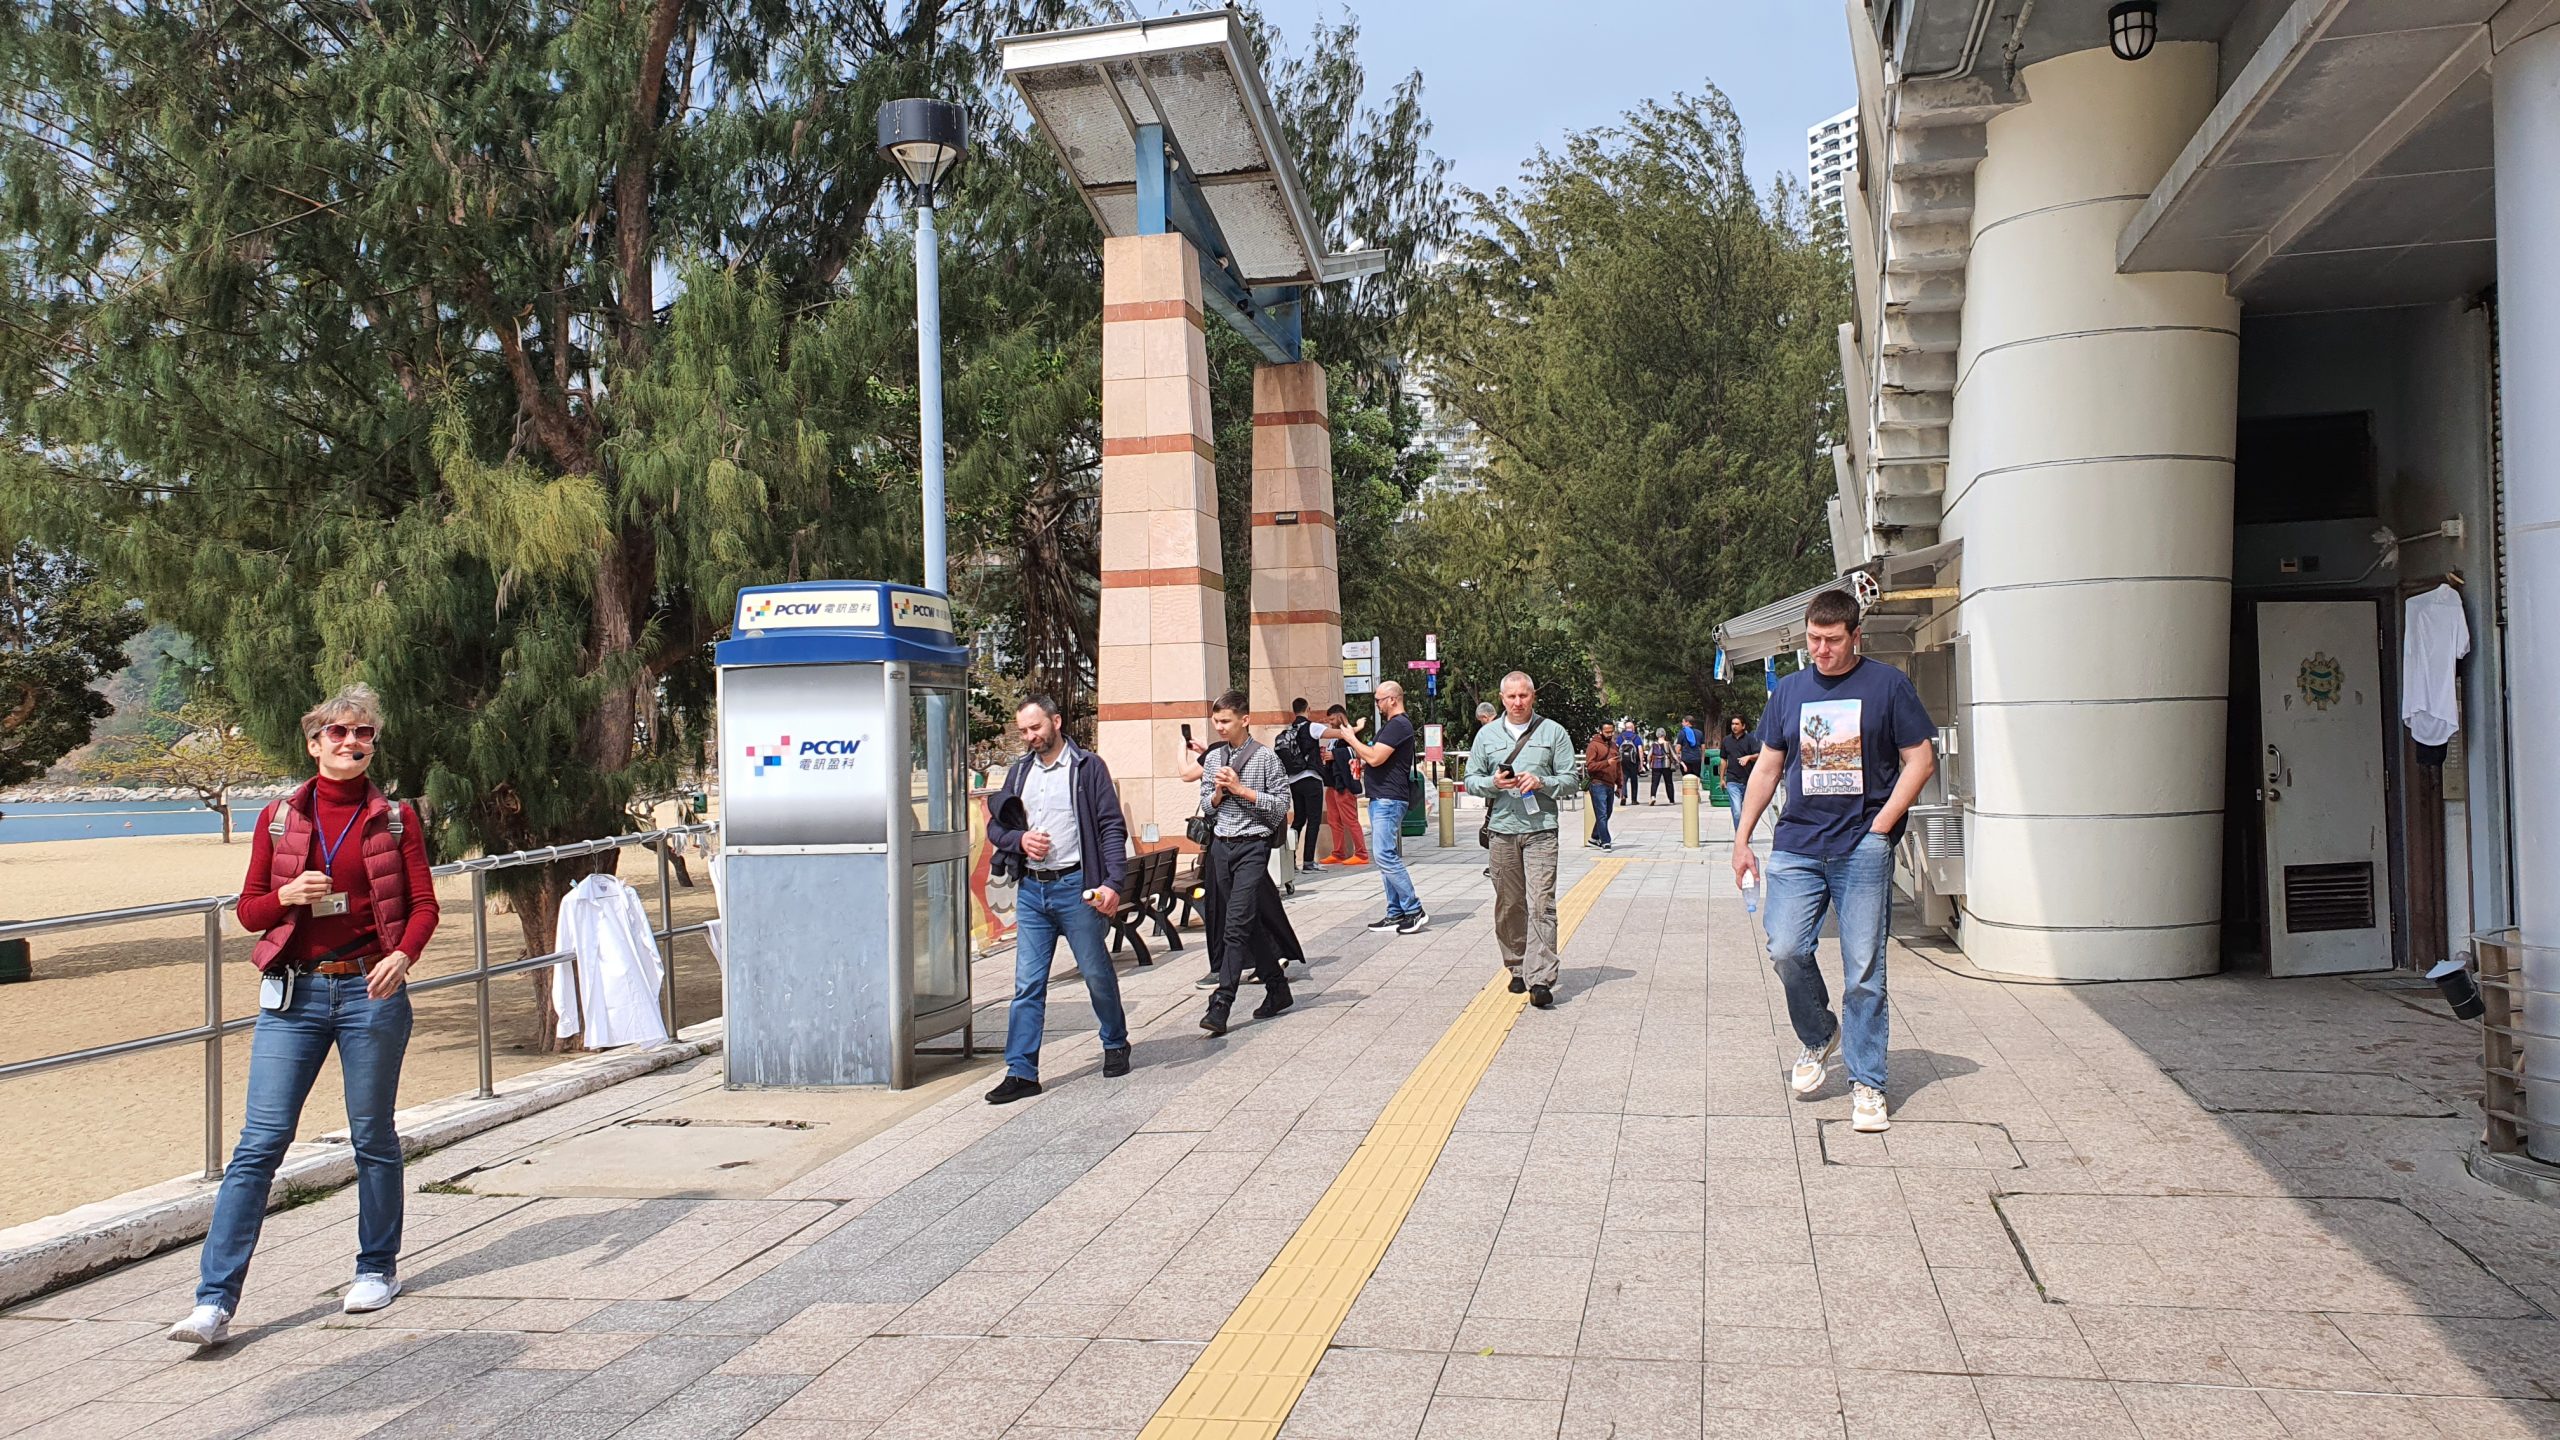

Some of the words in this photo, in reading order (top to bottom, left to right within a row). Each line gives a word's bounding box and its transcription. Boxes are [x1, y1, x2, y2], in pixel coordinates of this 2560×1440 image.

[775, 603, 822, 615] PCCW
[824, 603, 872, 614] 電訊盈科
[913, 604, 935, 618] PCCW
[799, 739, 861, 756] PCCW
[799, 757, 855, 771] 電訊盈科
[1810, 772, 1854, 788] GUESS
